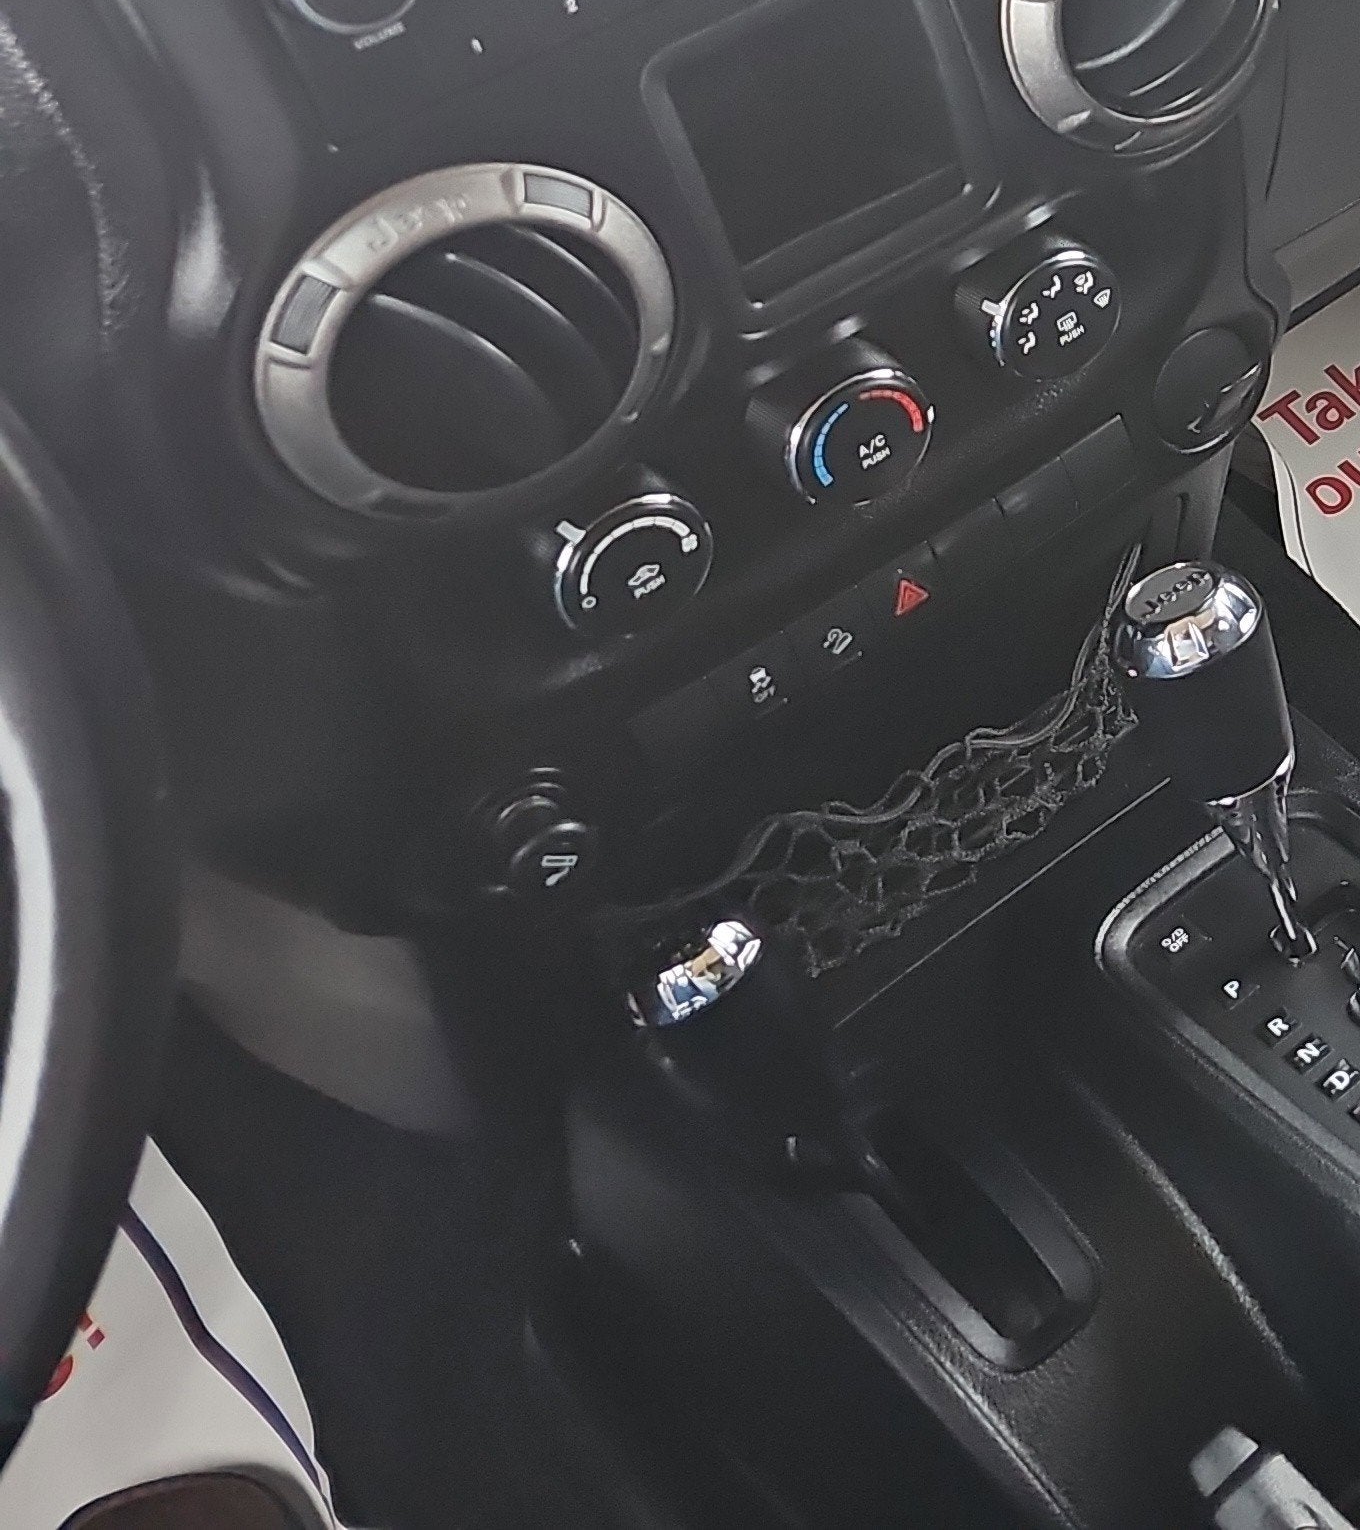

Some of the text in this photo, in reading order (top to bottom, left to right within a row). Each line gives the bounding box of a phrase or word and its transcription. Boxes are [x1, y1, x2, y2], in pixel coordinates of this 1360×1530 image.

[1059, 324, 1085, 347] PUSH
[859, 433, 886, 458] A/C
[862, 446, 891, 470] PUSH
[633, 574, 666, 599] PUSH
[1140, 571, 1213, 625] Jeep
[1169, 932, 1189, 953] OFF
[1223, 980, 1240, 999] P
[1267, 1018, 1290, 1037] R
[1297, 1042, 1321, 1064] N
[1322, 1070, 1351, 1091] D
